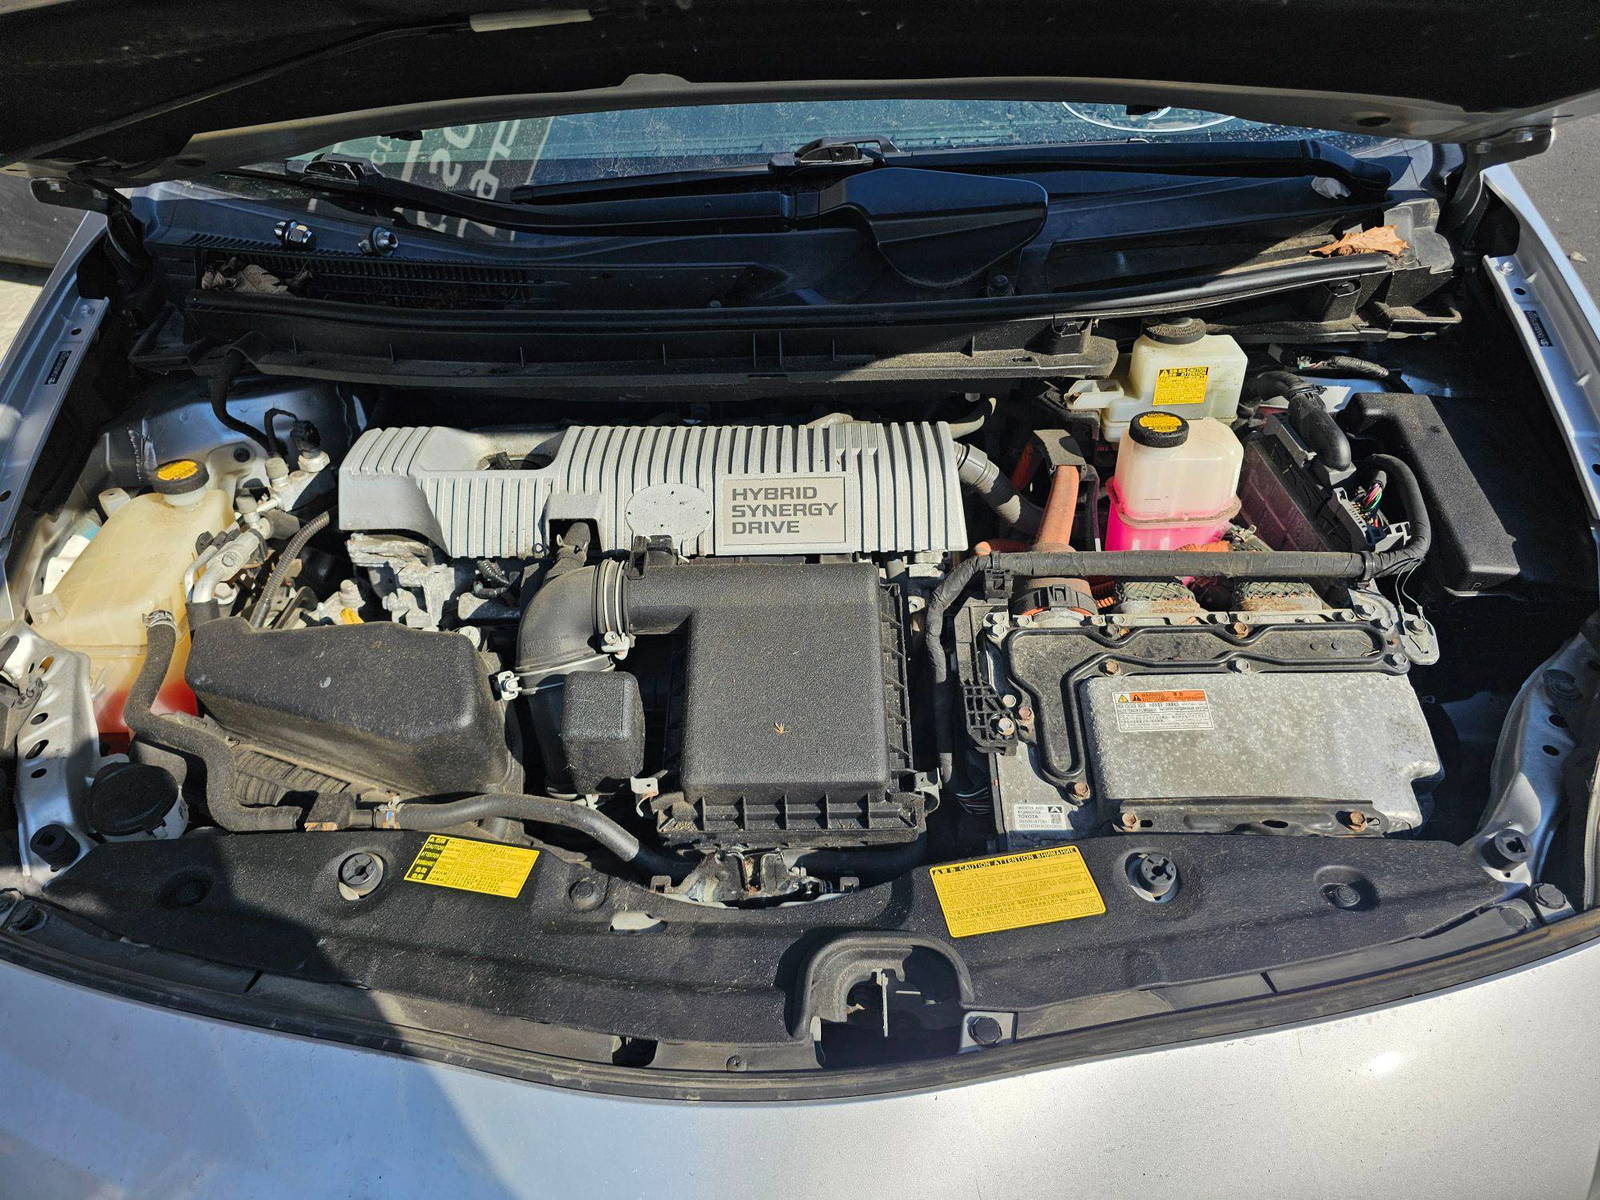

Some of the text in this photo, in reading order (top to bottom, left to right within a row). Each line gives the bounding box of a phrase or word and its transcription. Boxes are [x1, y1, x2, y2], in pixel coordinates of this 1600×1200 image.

[732, 486, 818, 501] HYBRID
[731, 502, 839, 518] SYNERGY
[732, 520, 800, 535] DRIVE
[958, 861, 991, 871] CAUTION
[993, 854, 1034, 866] ATTENTION
